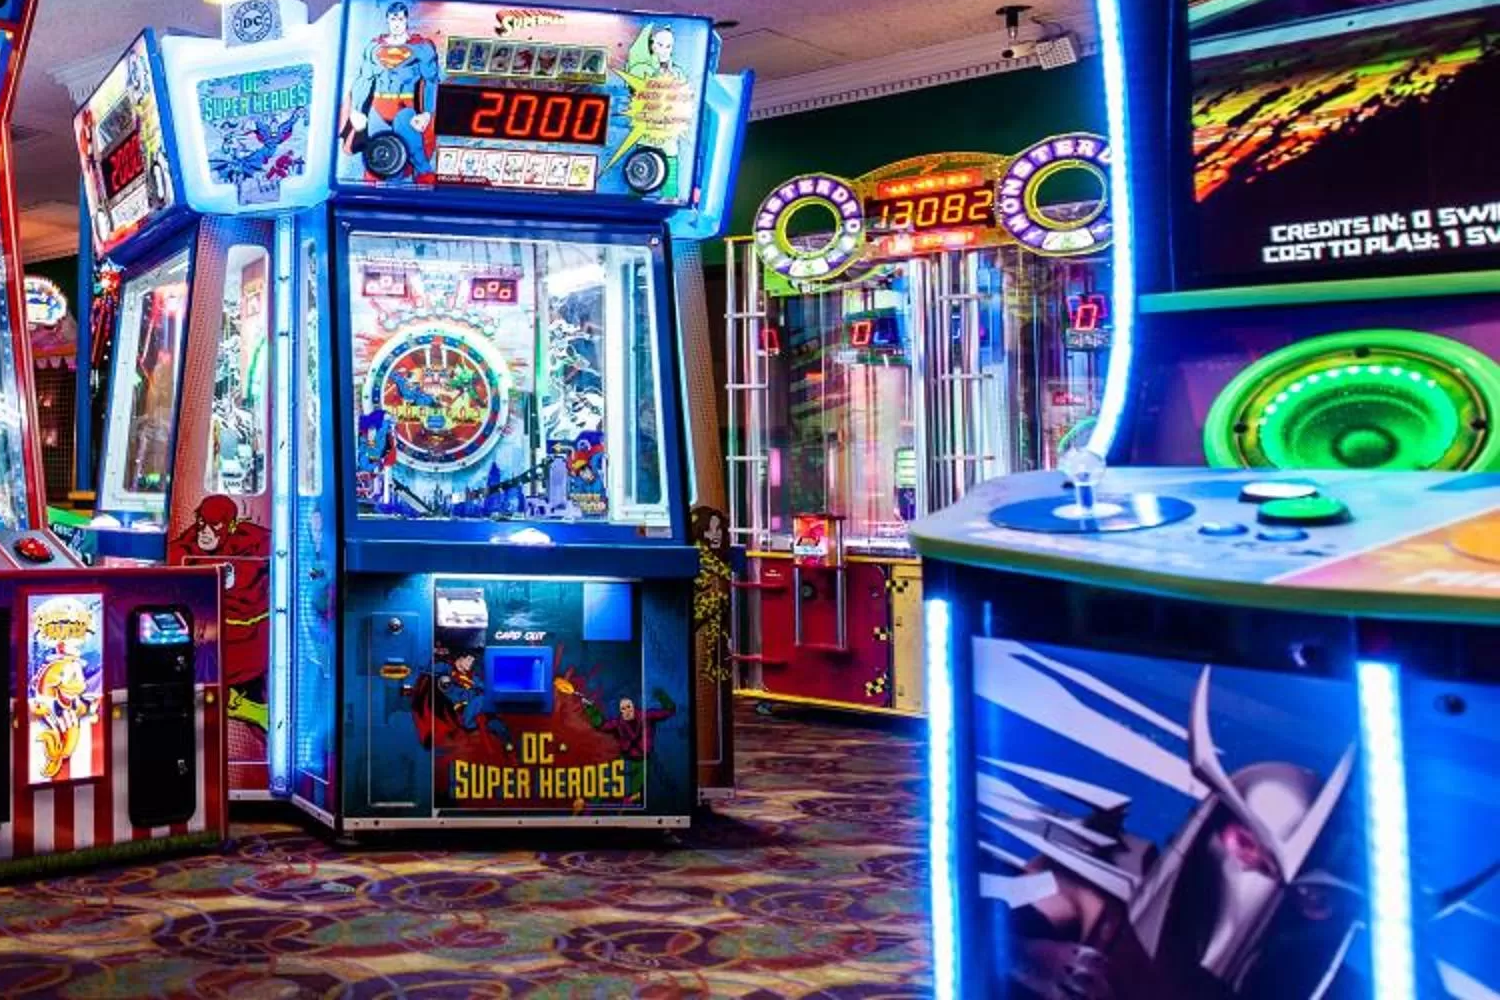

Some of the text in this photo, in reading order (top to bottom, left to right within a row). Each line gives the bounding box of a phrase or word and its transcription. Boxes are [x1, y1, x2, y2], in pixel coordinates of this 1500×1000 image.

[243, 73, 261, 94] DC
[204, 84, 308, 121] SUPER HEROES
[472, 91, 605, 143] 2000
[880, 189, 993, 229] 13082
[1270, 215, 1370, 243] CREDITS
[1373, 212, 1407, 233] IN:
[1437, 202, 1500, 227] SWI
[1262, 242, 1322, 263] COST
[1324, 238, 1362, 259] TO
[1364, 231, 1441, 255] PLAY:
[1445, 229, 1461, 248] 1
[494, 630, 547, 641] CARD OUT
[521, 732, 555, 764] DC
[455, 758, 626, 799] SUPER HEROES
